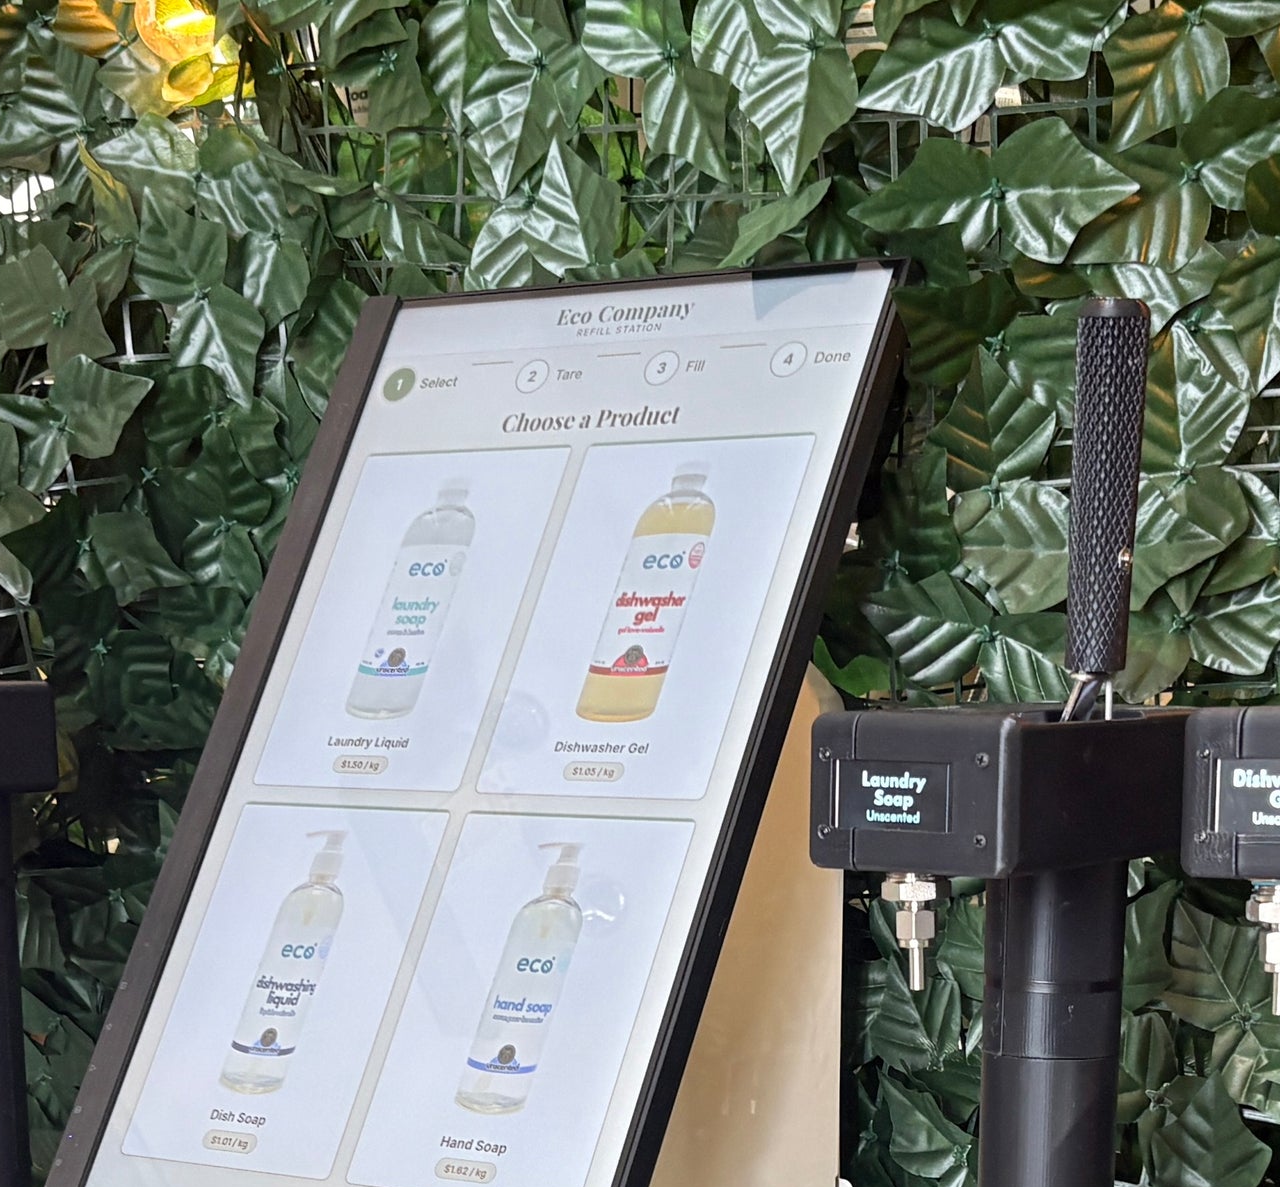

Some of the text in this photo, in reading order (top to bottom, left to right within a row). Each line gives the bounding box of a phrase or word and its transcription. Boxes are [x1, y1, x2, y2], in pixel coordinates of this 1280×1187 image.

[557, 303, 695, 326] Eco Company
[576, 323, 662, 337] REFILL STATION
[783, 351, 851, 366] 4 Done
[528, 369, 583, 383] 2 Tare
[657, 360, 706, 375] 3 Fill
[420, 376, 458, 389] Select
[502, 406, 680, 434] Choose a Product
[409, 559, 447, 576] eco
[643, 552, 685, 569] eco
[392, 597, 439, 614] laundry
[616, 591, 686, 607] dishwasher
[633, 607, 659, 625] gel
[328, 736, 409, 750] Laundry Liquid
[553, 741, 649, 754] Dishwasher Gel
[862, 770, 926, 793] Laundry
[874, 789, 914, 811] Soap
[866, 809, 920, 824] Unscented
[281, 943, 317, 959] eco
[517, 956, 556, 974] eco
[266, 991, 301, 1008] liquid
[493, 995, 552, 1017] hand soap
[210, 1109, 266, 1128] Dish Soap
[440, 1136, 507, 1156] Hand Soap
